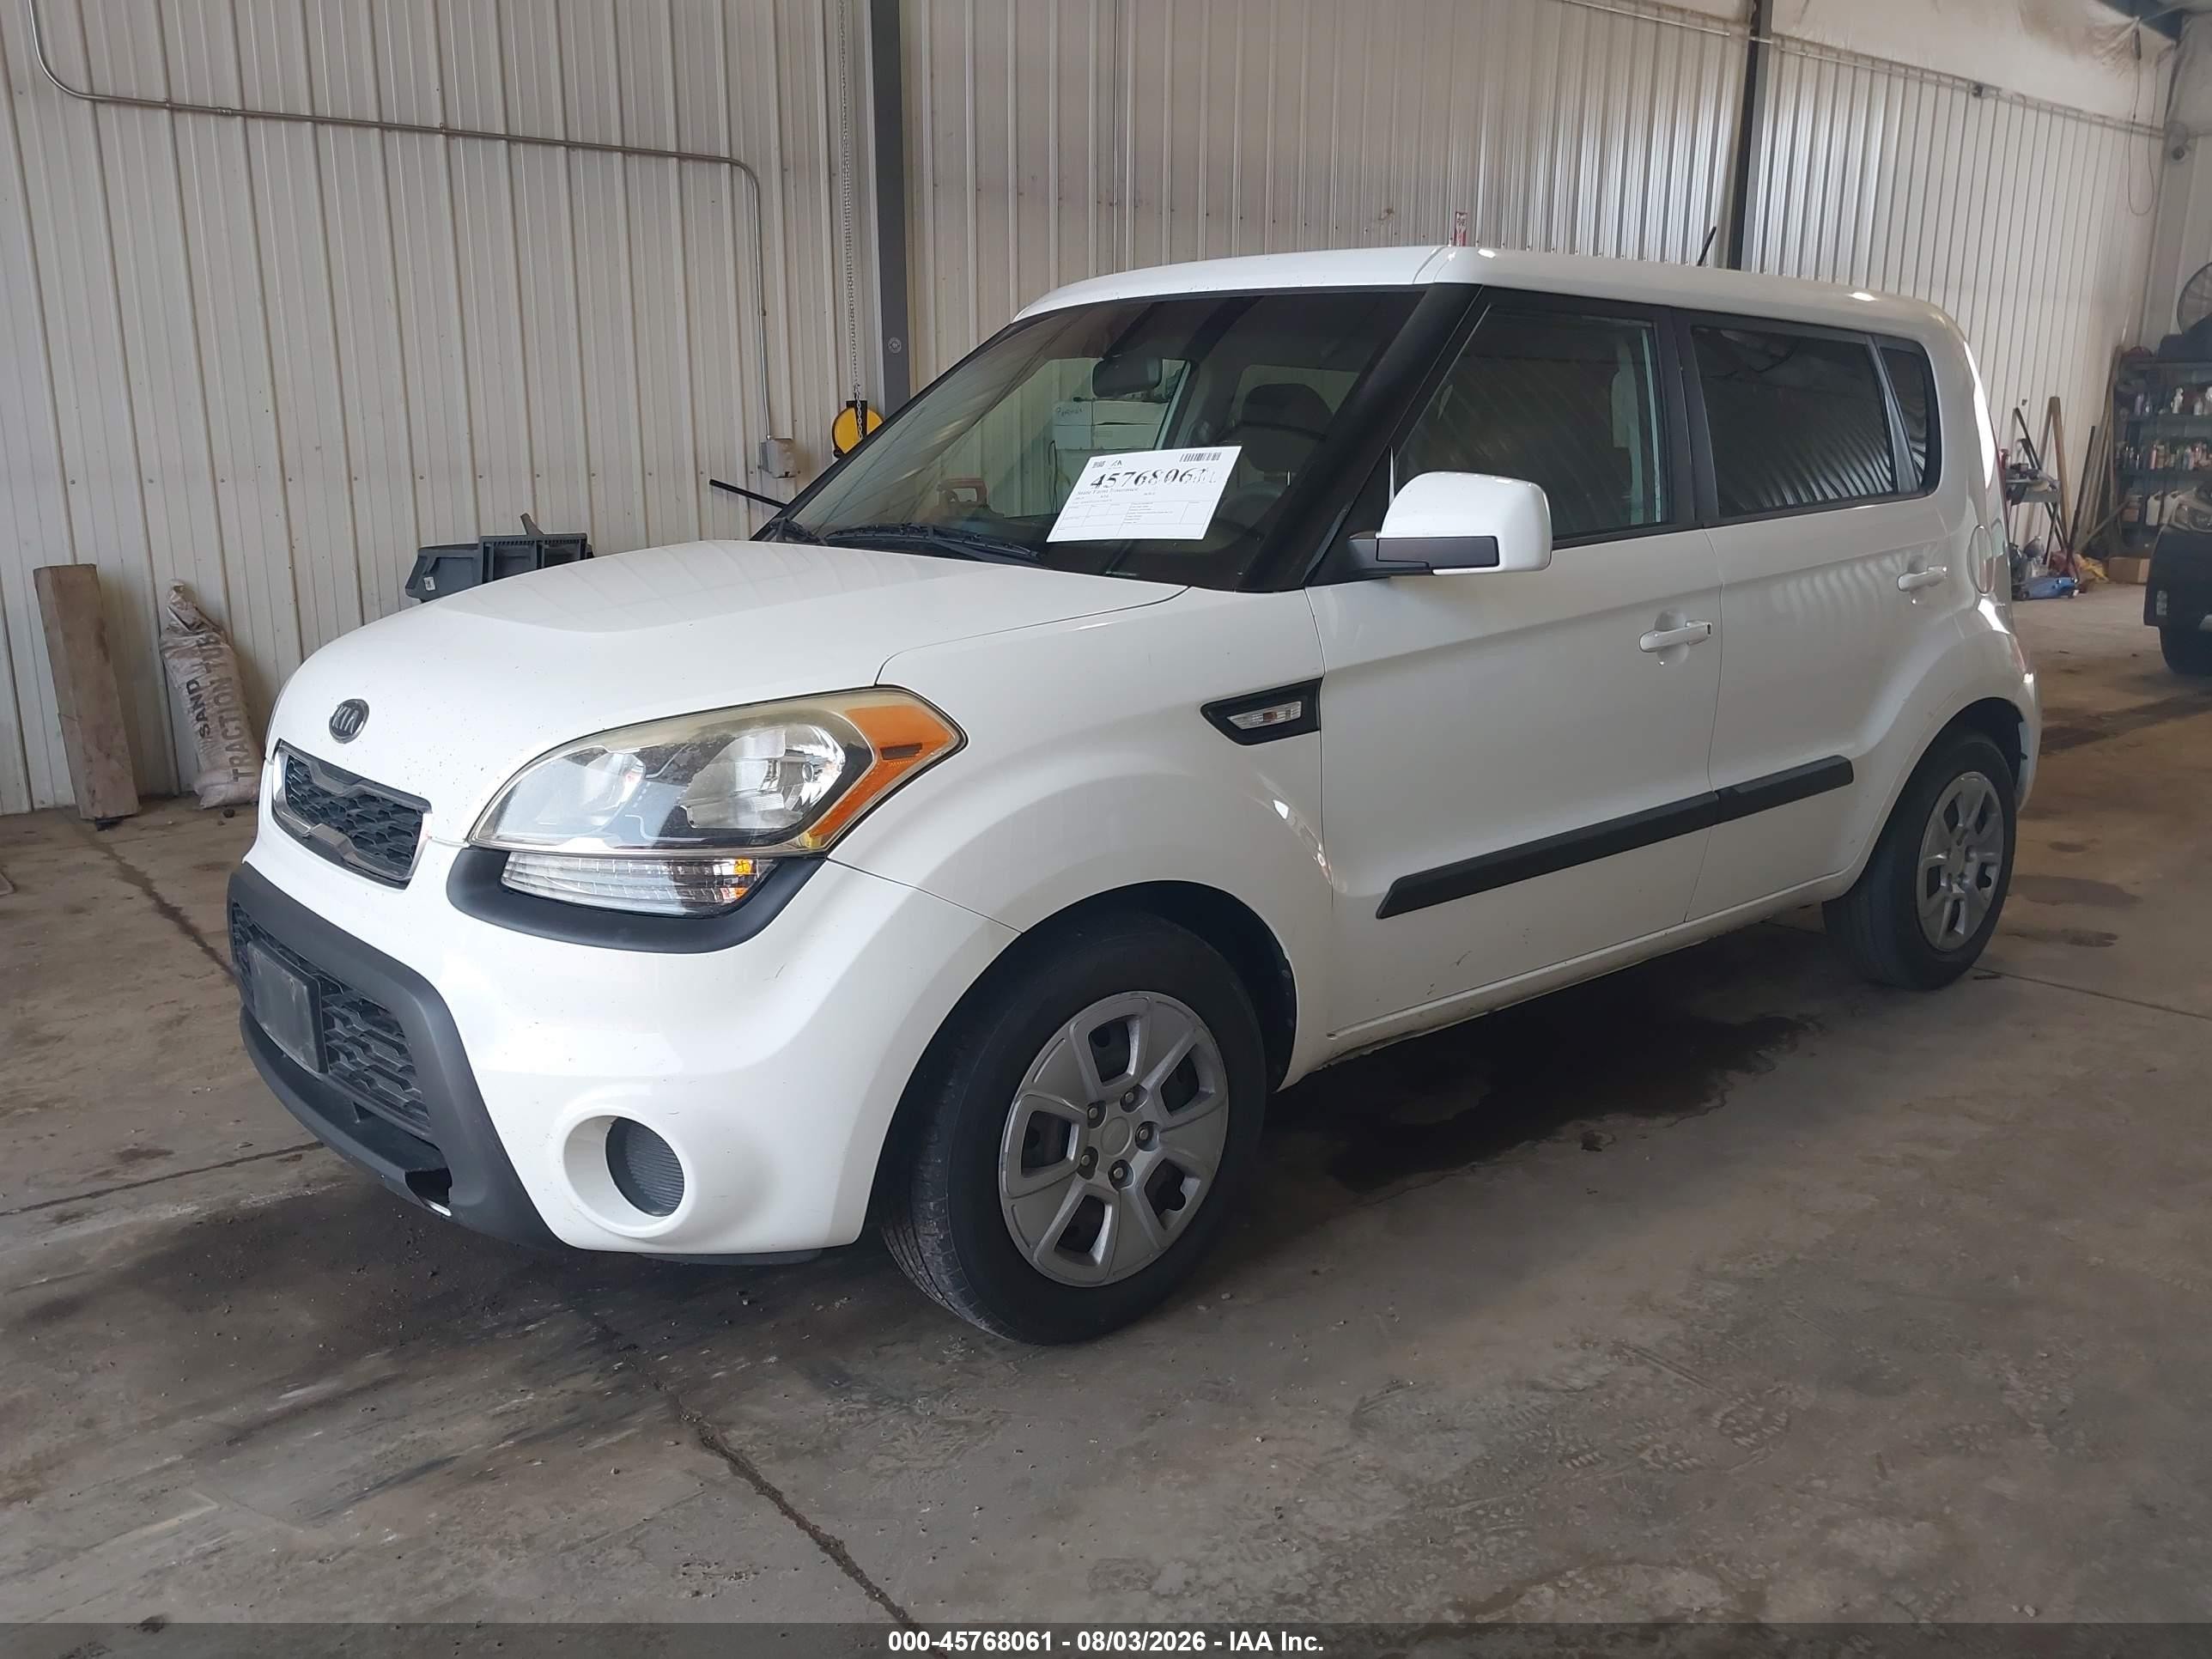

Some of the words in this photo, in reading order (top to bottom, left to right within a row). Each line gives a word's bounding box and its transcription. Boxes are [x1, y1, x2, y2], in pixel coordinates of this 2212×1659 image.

[185, 679, 211, 739] SAND
[210, 677, 256, 783] TRACTION
[331, 705, 360, 734] KIA
